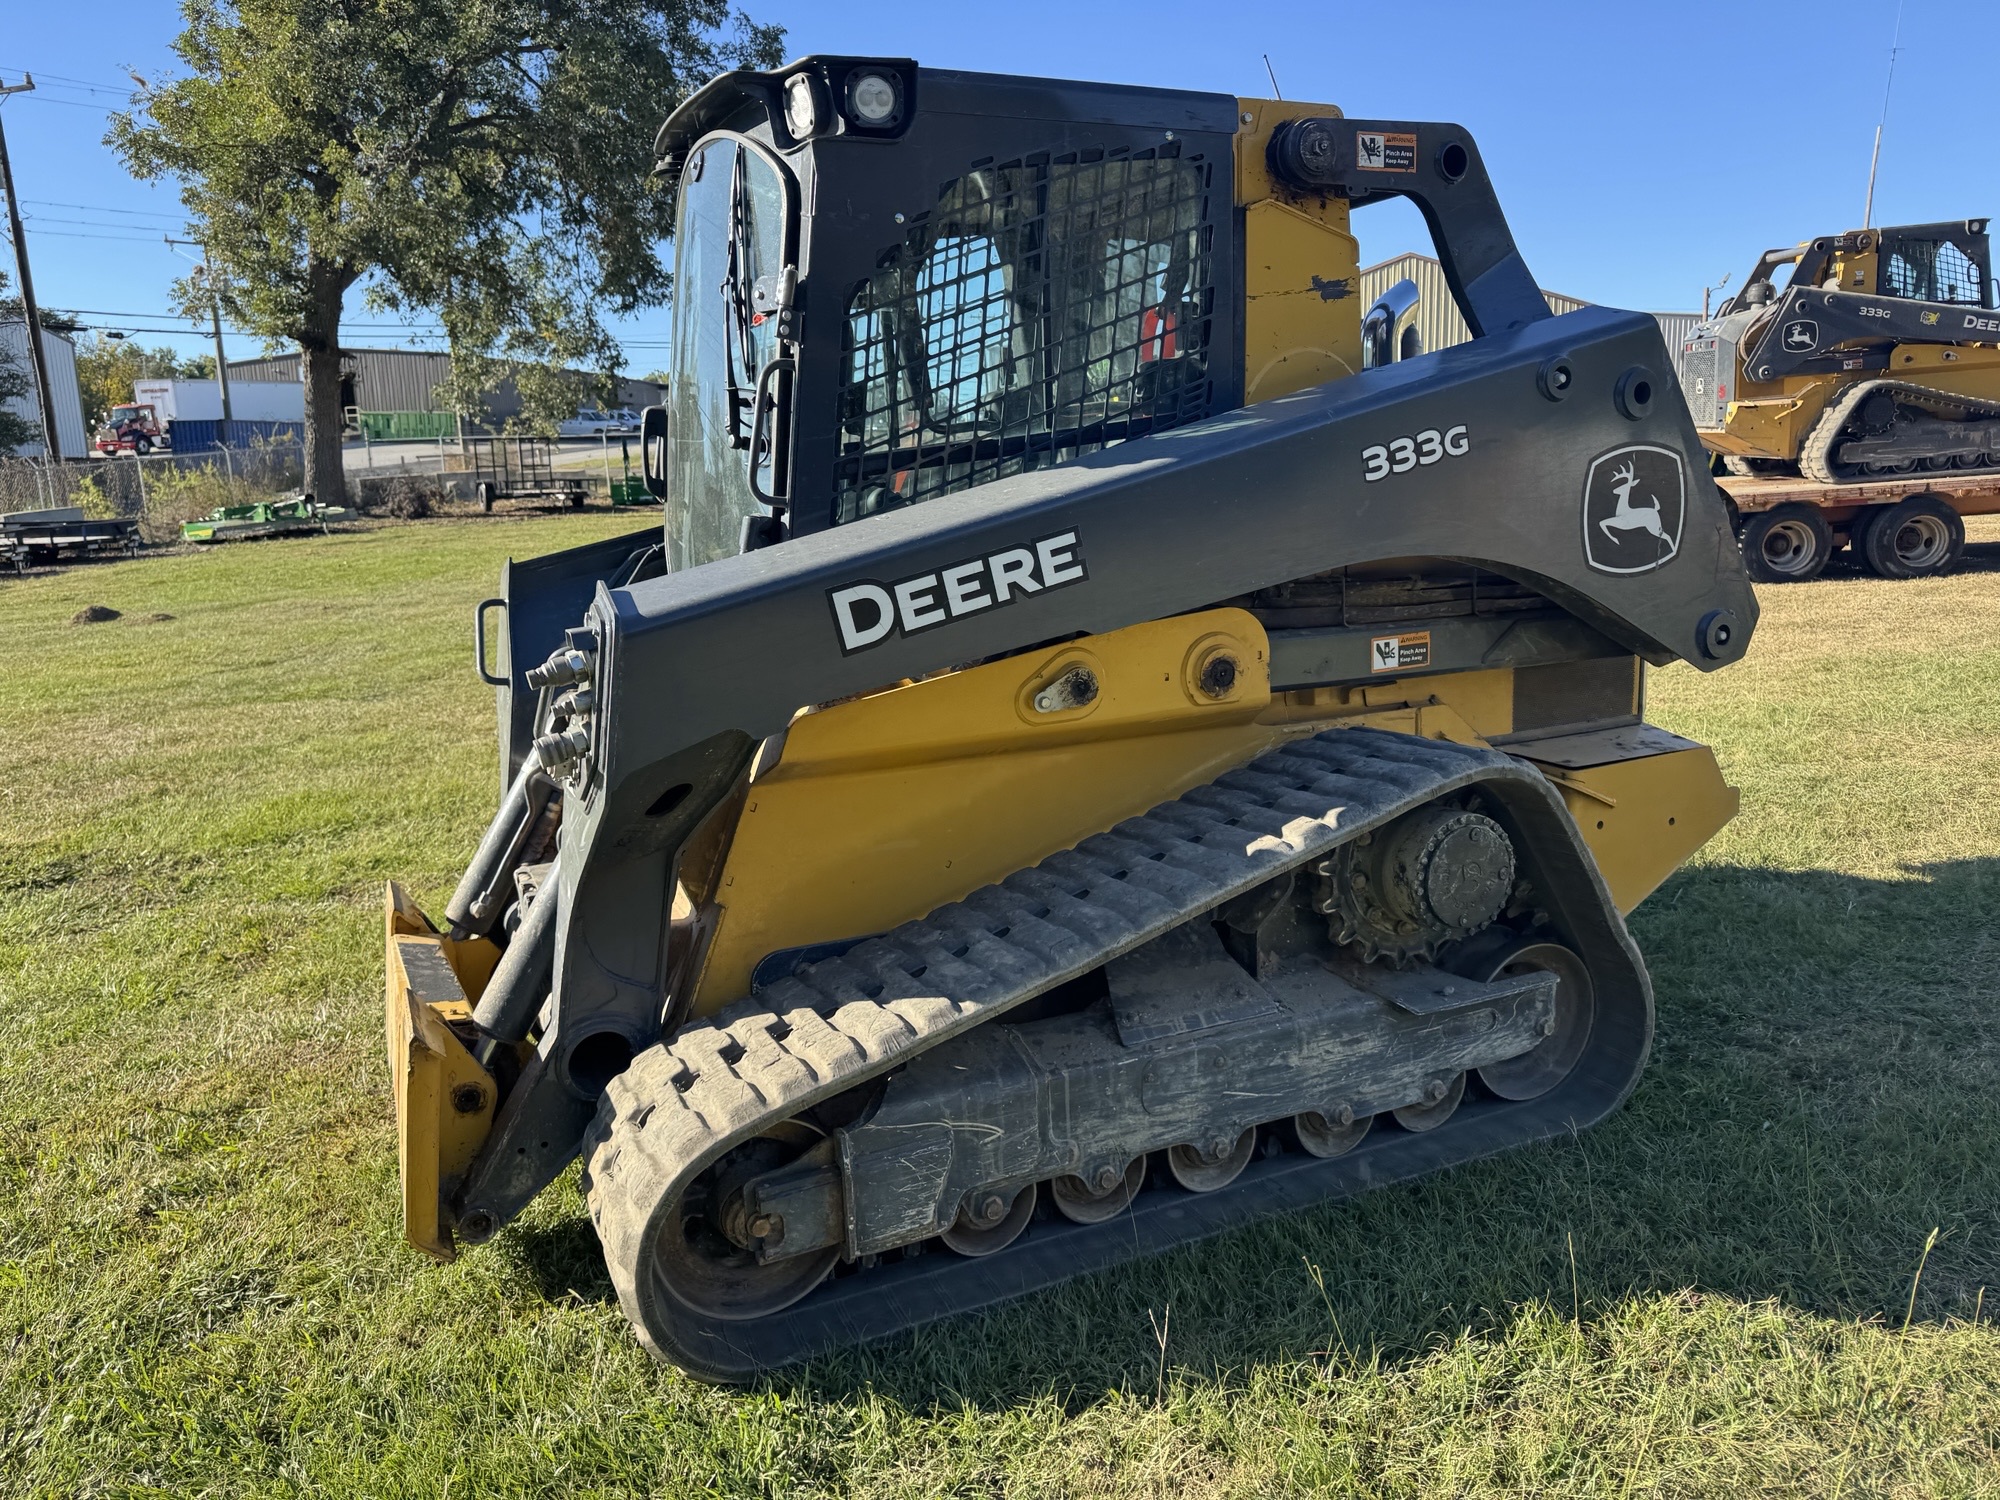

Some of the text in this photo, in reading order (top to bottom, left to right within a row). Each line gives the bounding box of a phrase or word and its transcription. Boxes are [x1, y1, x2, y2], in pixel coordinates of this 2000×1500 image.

[1859, 306, 1891, 319] 333G
[1963, 314, 2000, 332] DEE
[1362, 425, 1469, 481] 333G
[832, 531, 1084, 650] DEERE
[1405, 634, 1428, 642] WARNING
